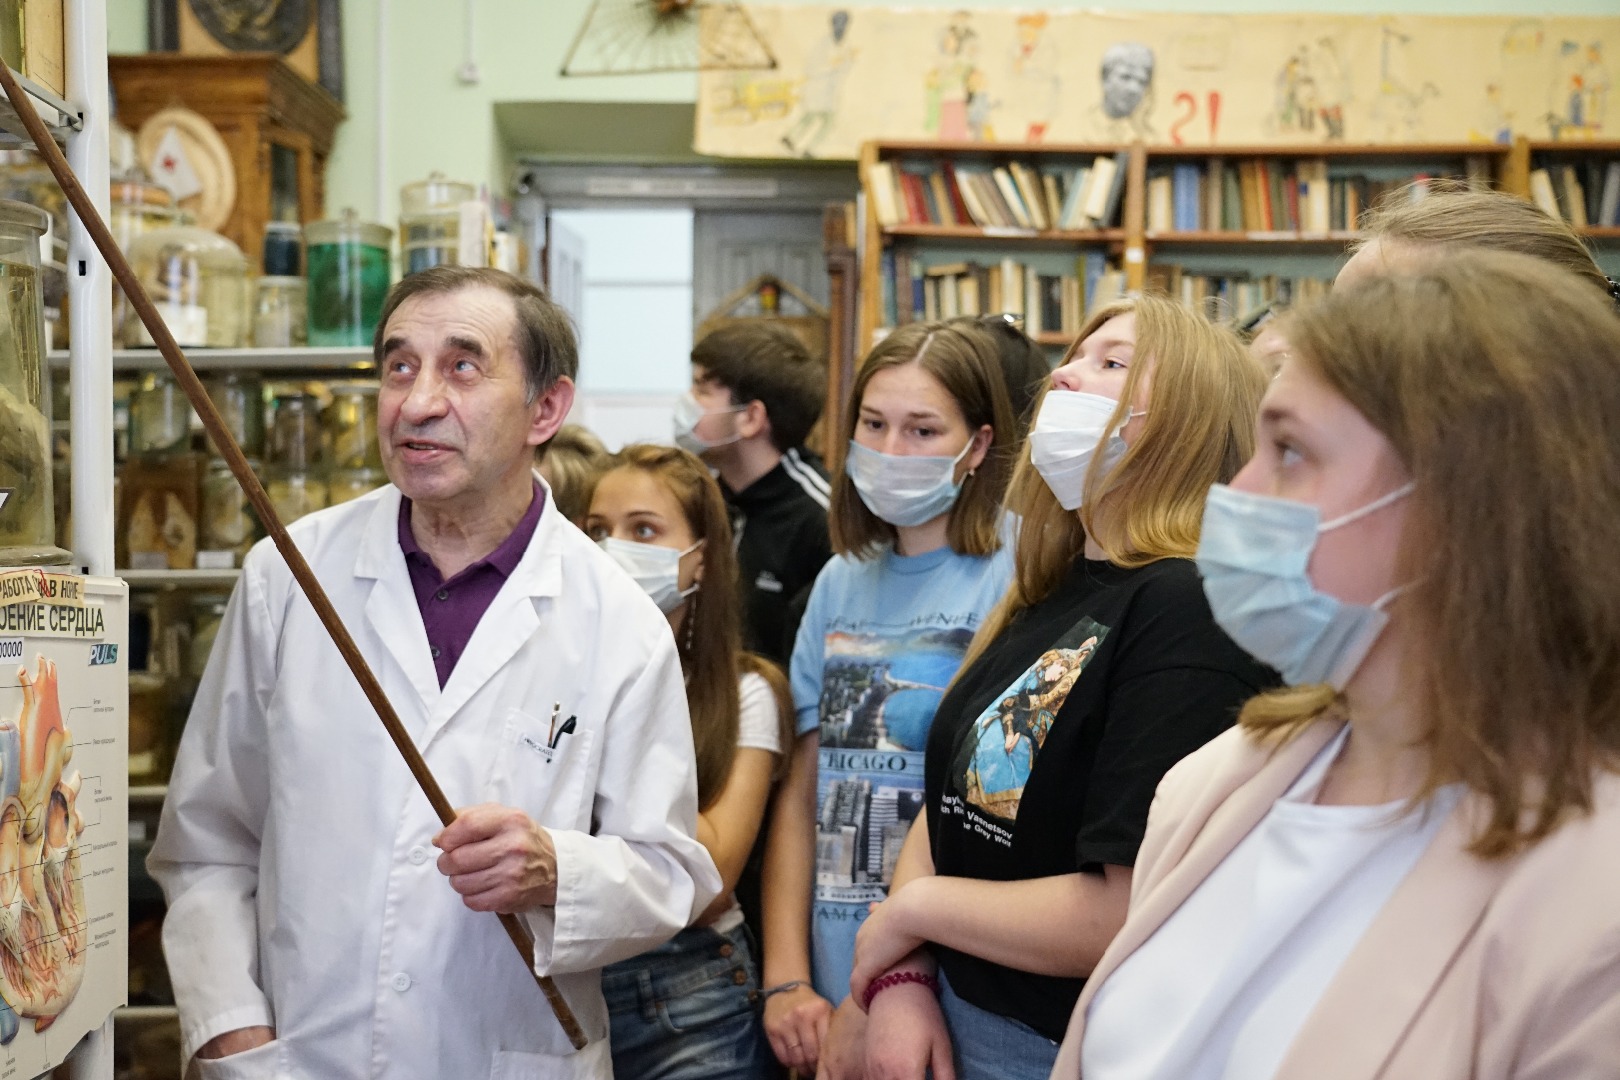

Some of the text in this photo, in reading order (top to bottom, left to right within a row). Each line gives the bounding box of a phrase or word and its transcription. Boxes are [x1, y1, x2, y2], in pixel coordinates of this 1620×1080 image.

[49, 605, 105, 637] СЕРДЦА
[89, 645, 117, 665] PULS
[967, 810, 1013, 840] Vasnetsov
[974, 824, 991, 840] Grey
